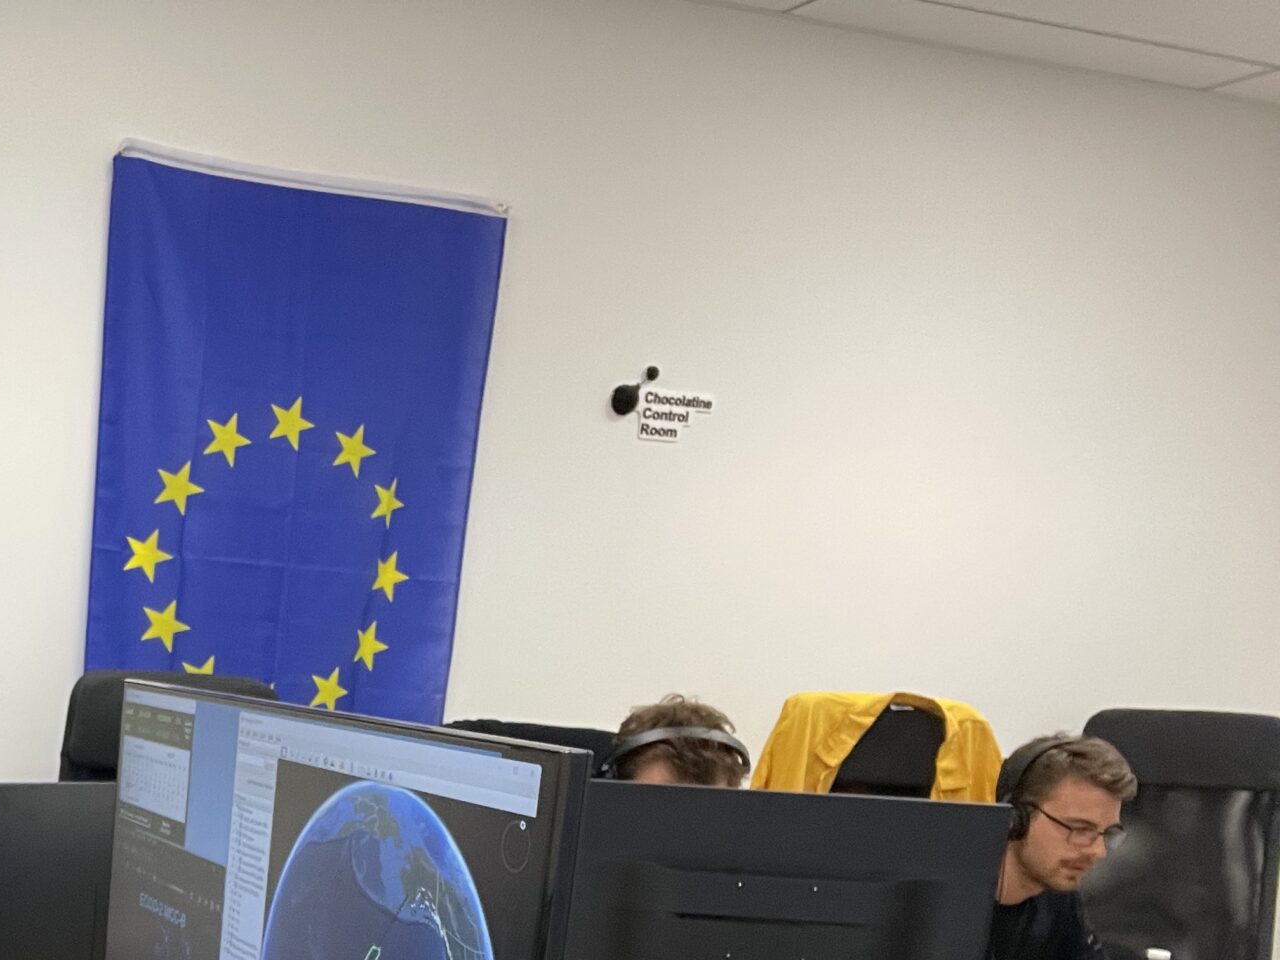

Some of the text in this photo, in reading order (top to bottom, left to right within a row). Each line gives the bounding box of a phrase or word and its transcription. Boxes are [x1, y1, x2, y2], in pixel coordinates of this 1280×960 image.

[645, 391, 713, 409] Chocolatine
[642, 407, 689, 423] Control
[640, 423, 678, 438] Room
